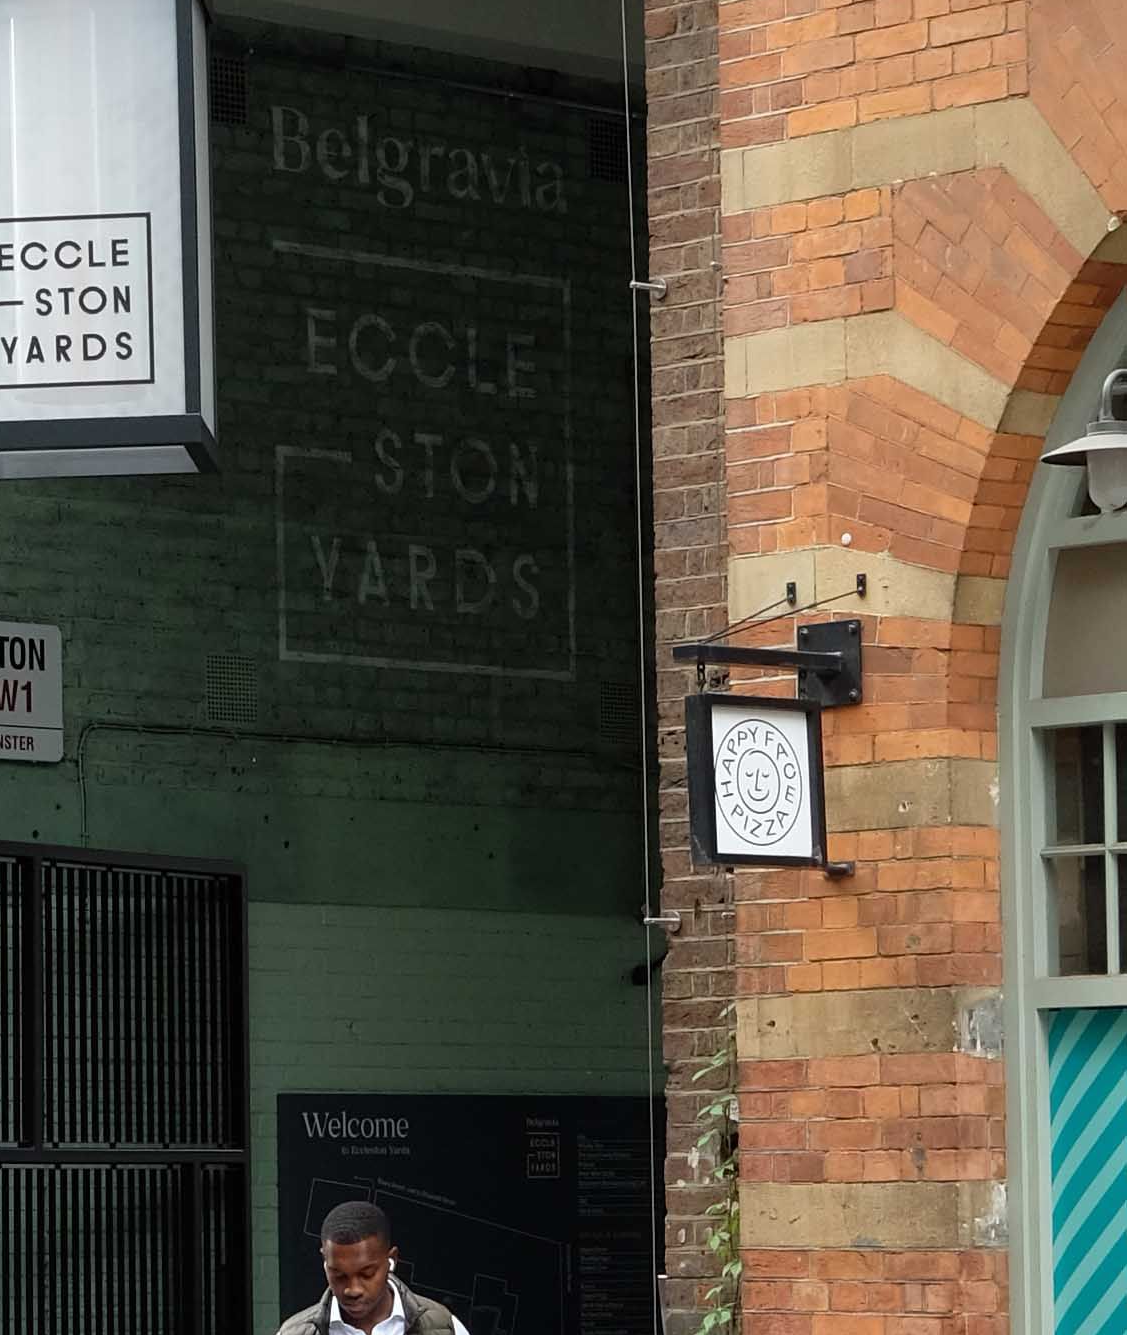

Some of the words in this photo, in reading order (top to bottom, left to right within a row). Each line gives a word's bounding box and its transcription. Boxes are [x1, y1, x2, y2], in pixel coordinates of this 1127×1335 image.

[271, 105, 568, 213] Belgravia
[34, 285, 131, 317] STON
[0, 331, 133, 365] YARDS
[306, 307, 538, 400] ECCLE
[374, 427, 539, 509] STON
[310, 534, 540, 620] YARDS
[720, 726, 760, 798] HAPPY
[764, 730, 797, 804] FACE
[730, 803, 790, 839] PIZZA
[301, 1110, 410, 1139] Welcome
